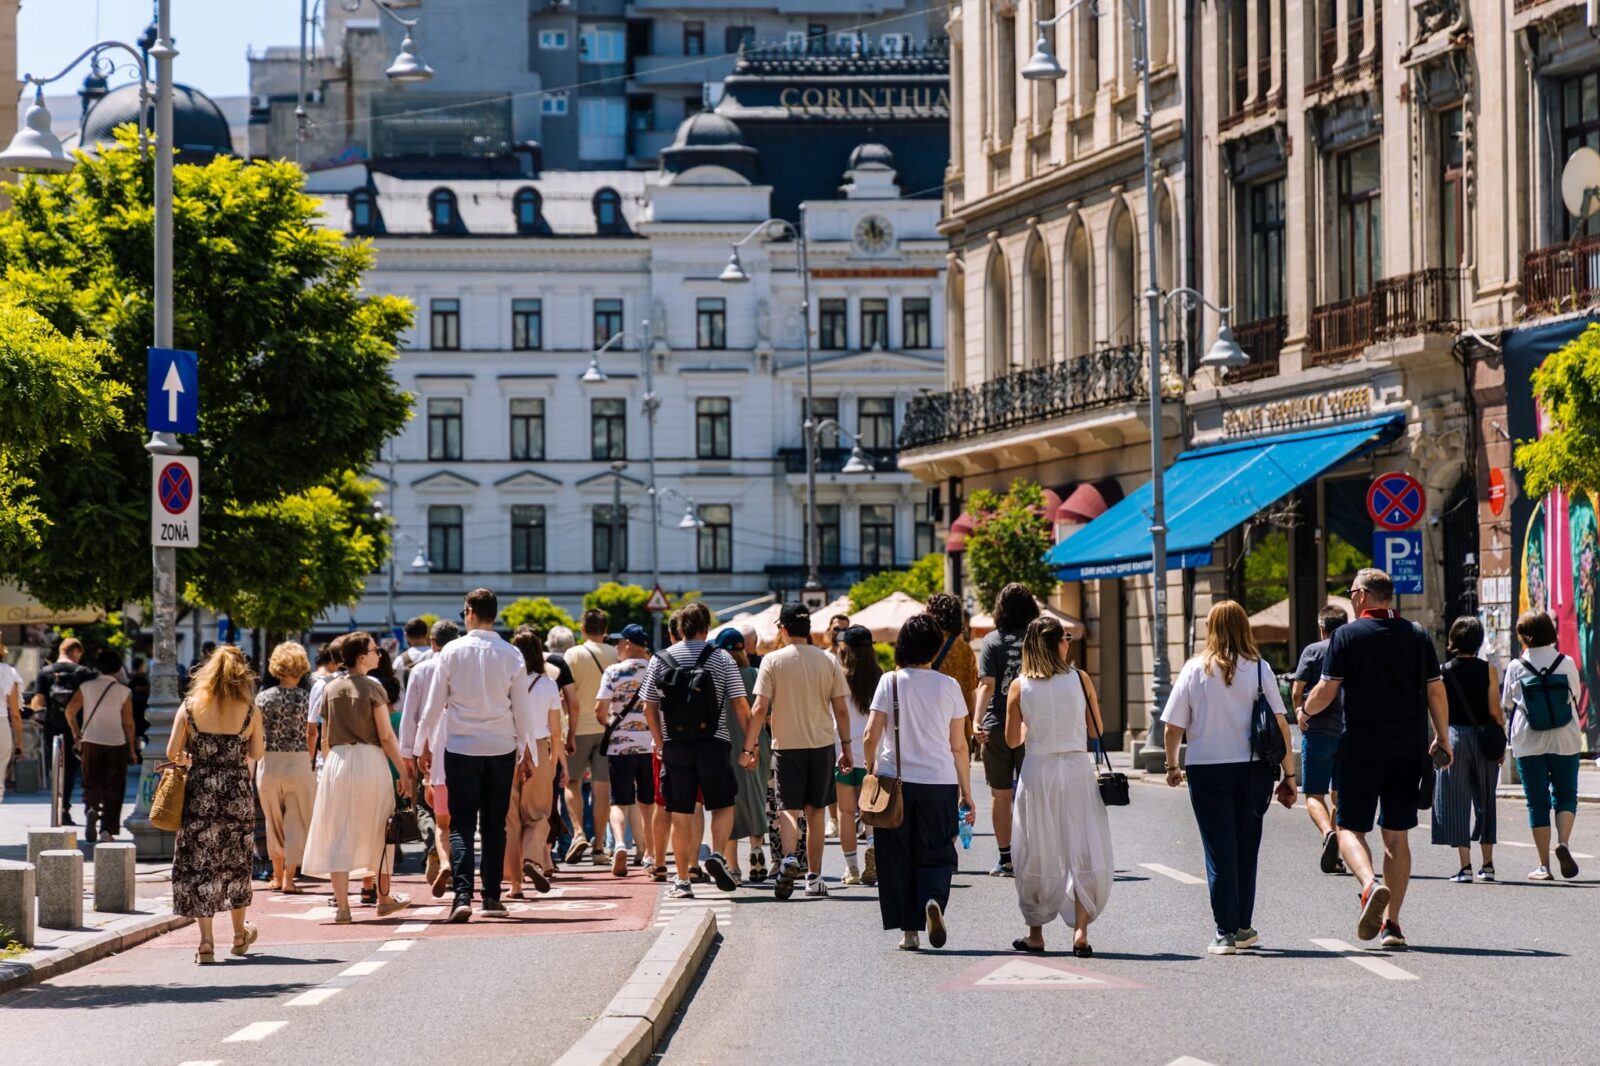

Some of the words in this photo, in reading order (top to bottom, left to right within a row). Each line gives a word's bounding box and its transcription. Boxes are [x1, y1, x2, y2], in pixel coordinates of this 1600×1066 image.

[779, 87, 950, 108] CORINTHIA
[161, 520, 189, 541] ZONĂ
[1385, 537, 1411, 575] P
